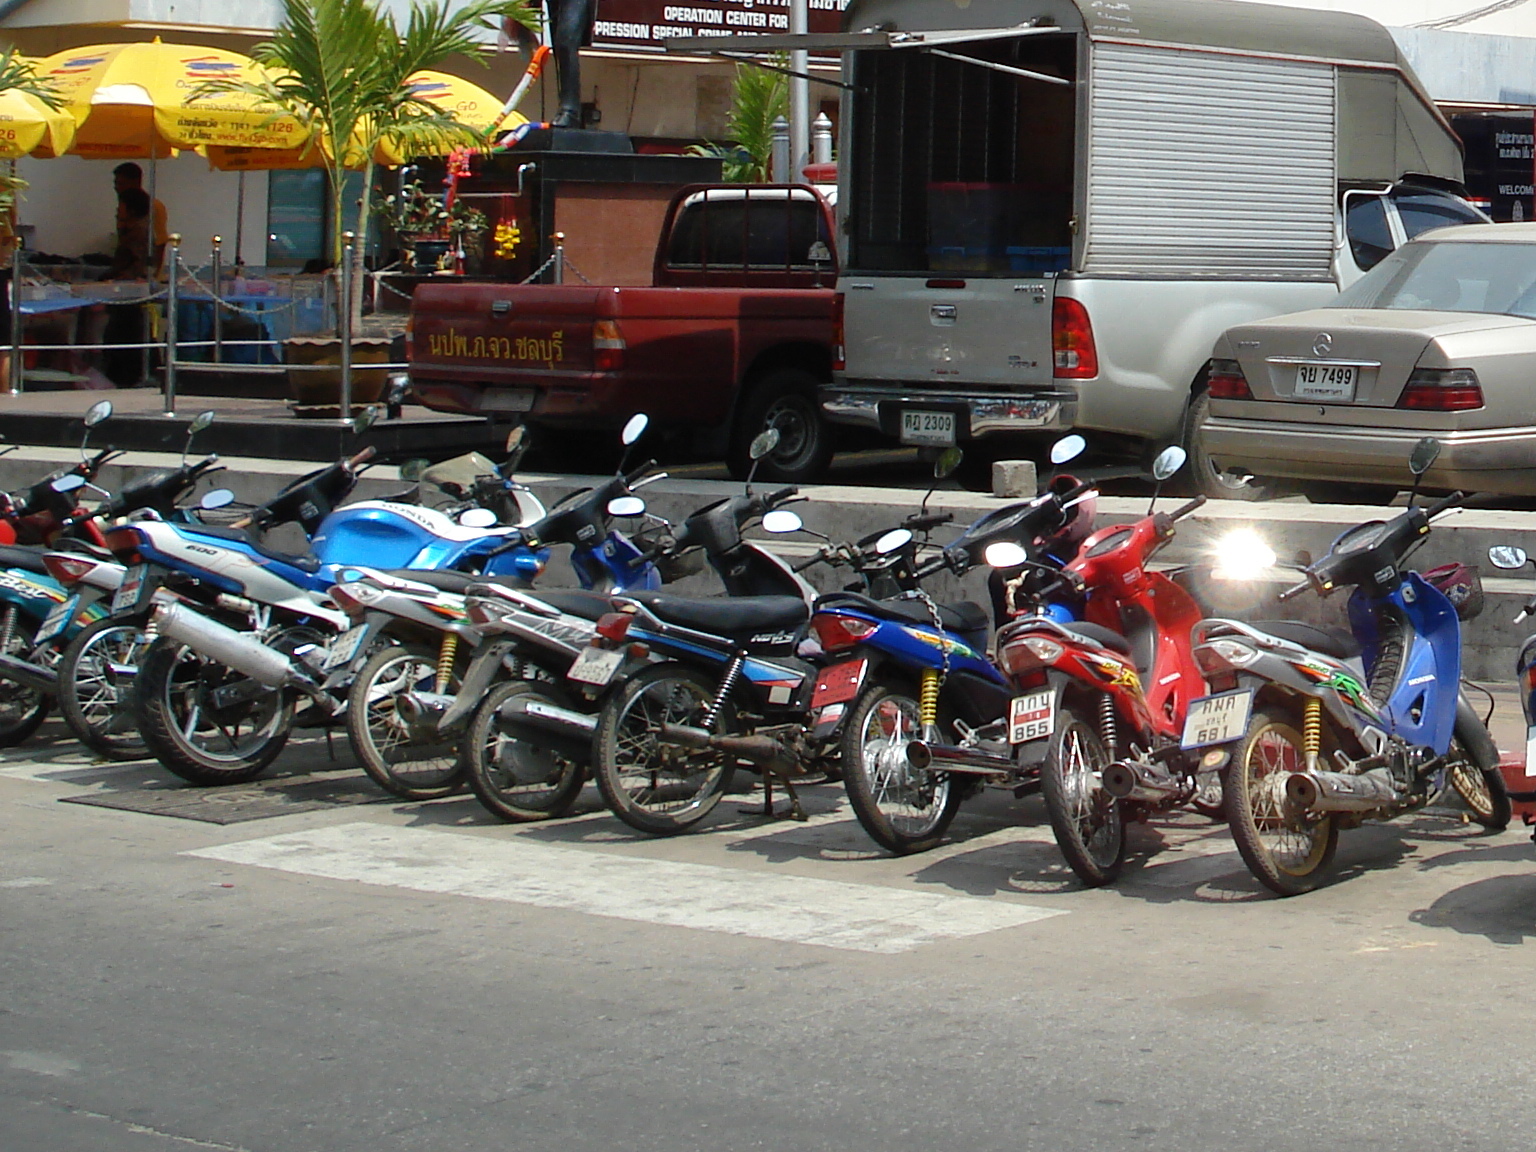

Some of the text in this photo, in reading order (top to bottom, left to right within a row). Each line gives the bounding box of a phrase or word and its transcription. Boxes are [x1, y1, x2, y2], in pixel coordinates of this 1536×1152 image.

[664, 6, 788, 29] OPERATION CENTER FOR
[594, 21, 649, 39] PRESSION
[1498, 184, 1534, 195] WELCOM
[1321, 367, 1352, 385] 7499
[924, 415, 951, 432] 2309
[382, 503, 436, 530] HONDA
[186, 545, 218, 556] 600
[1015, 721, 1048, 741] 855
[1198, 725, 1228, 743] 581
